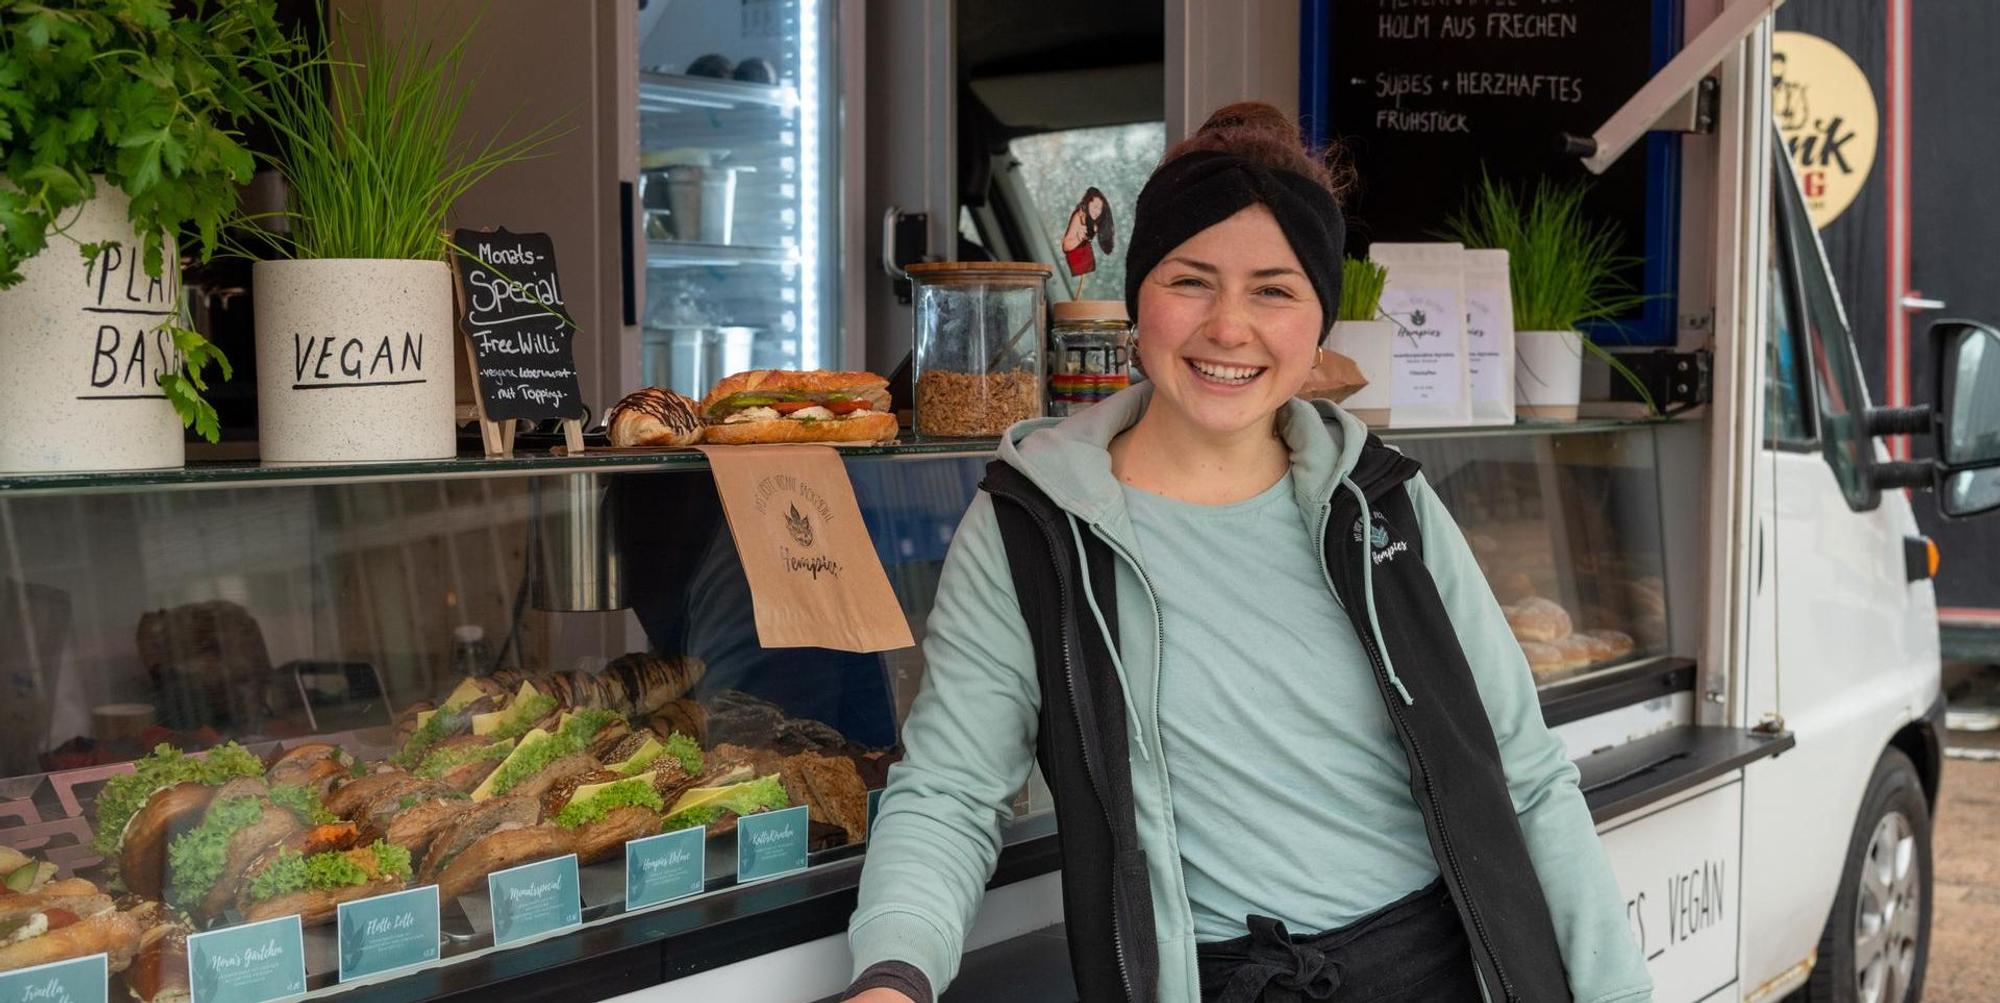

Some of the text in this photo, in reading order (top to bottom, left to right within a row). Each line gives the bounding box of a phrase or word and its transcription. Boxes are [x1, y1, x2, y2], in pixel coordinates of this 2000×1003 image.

[1378, 13, 1578, 39] HOLM AUS FRECHEN
[1456, 71, 1583, 103] HERZHAFTES
[469, 270, 564, 313] Special
[294, 331, 423, 382] VEGAN
